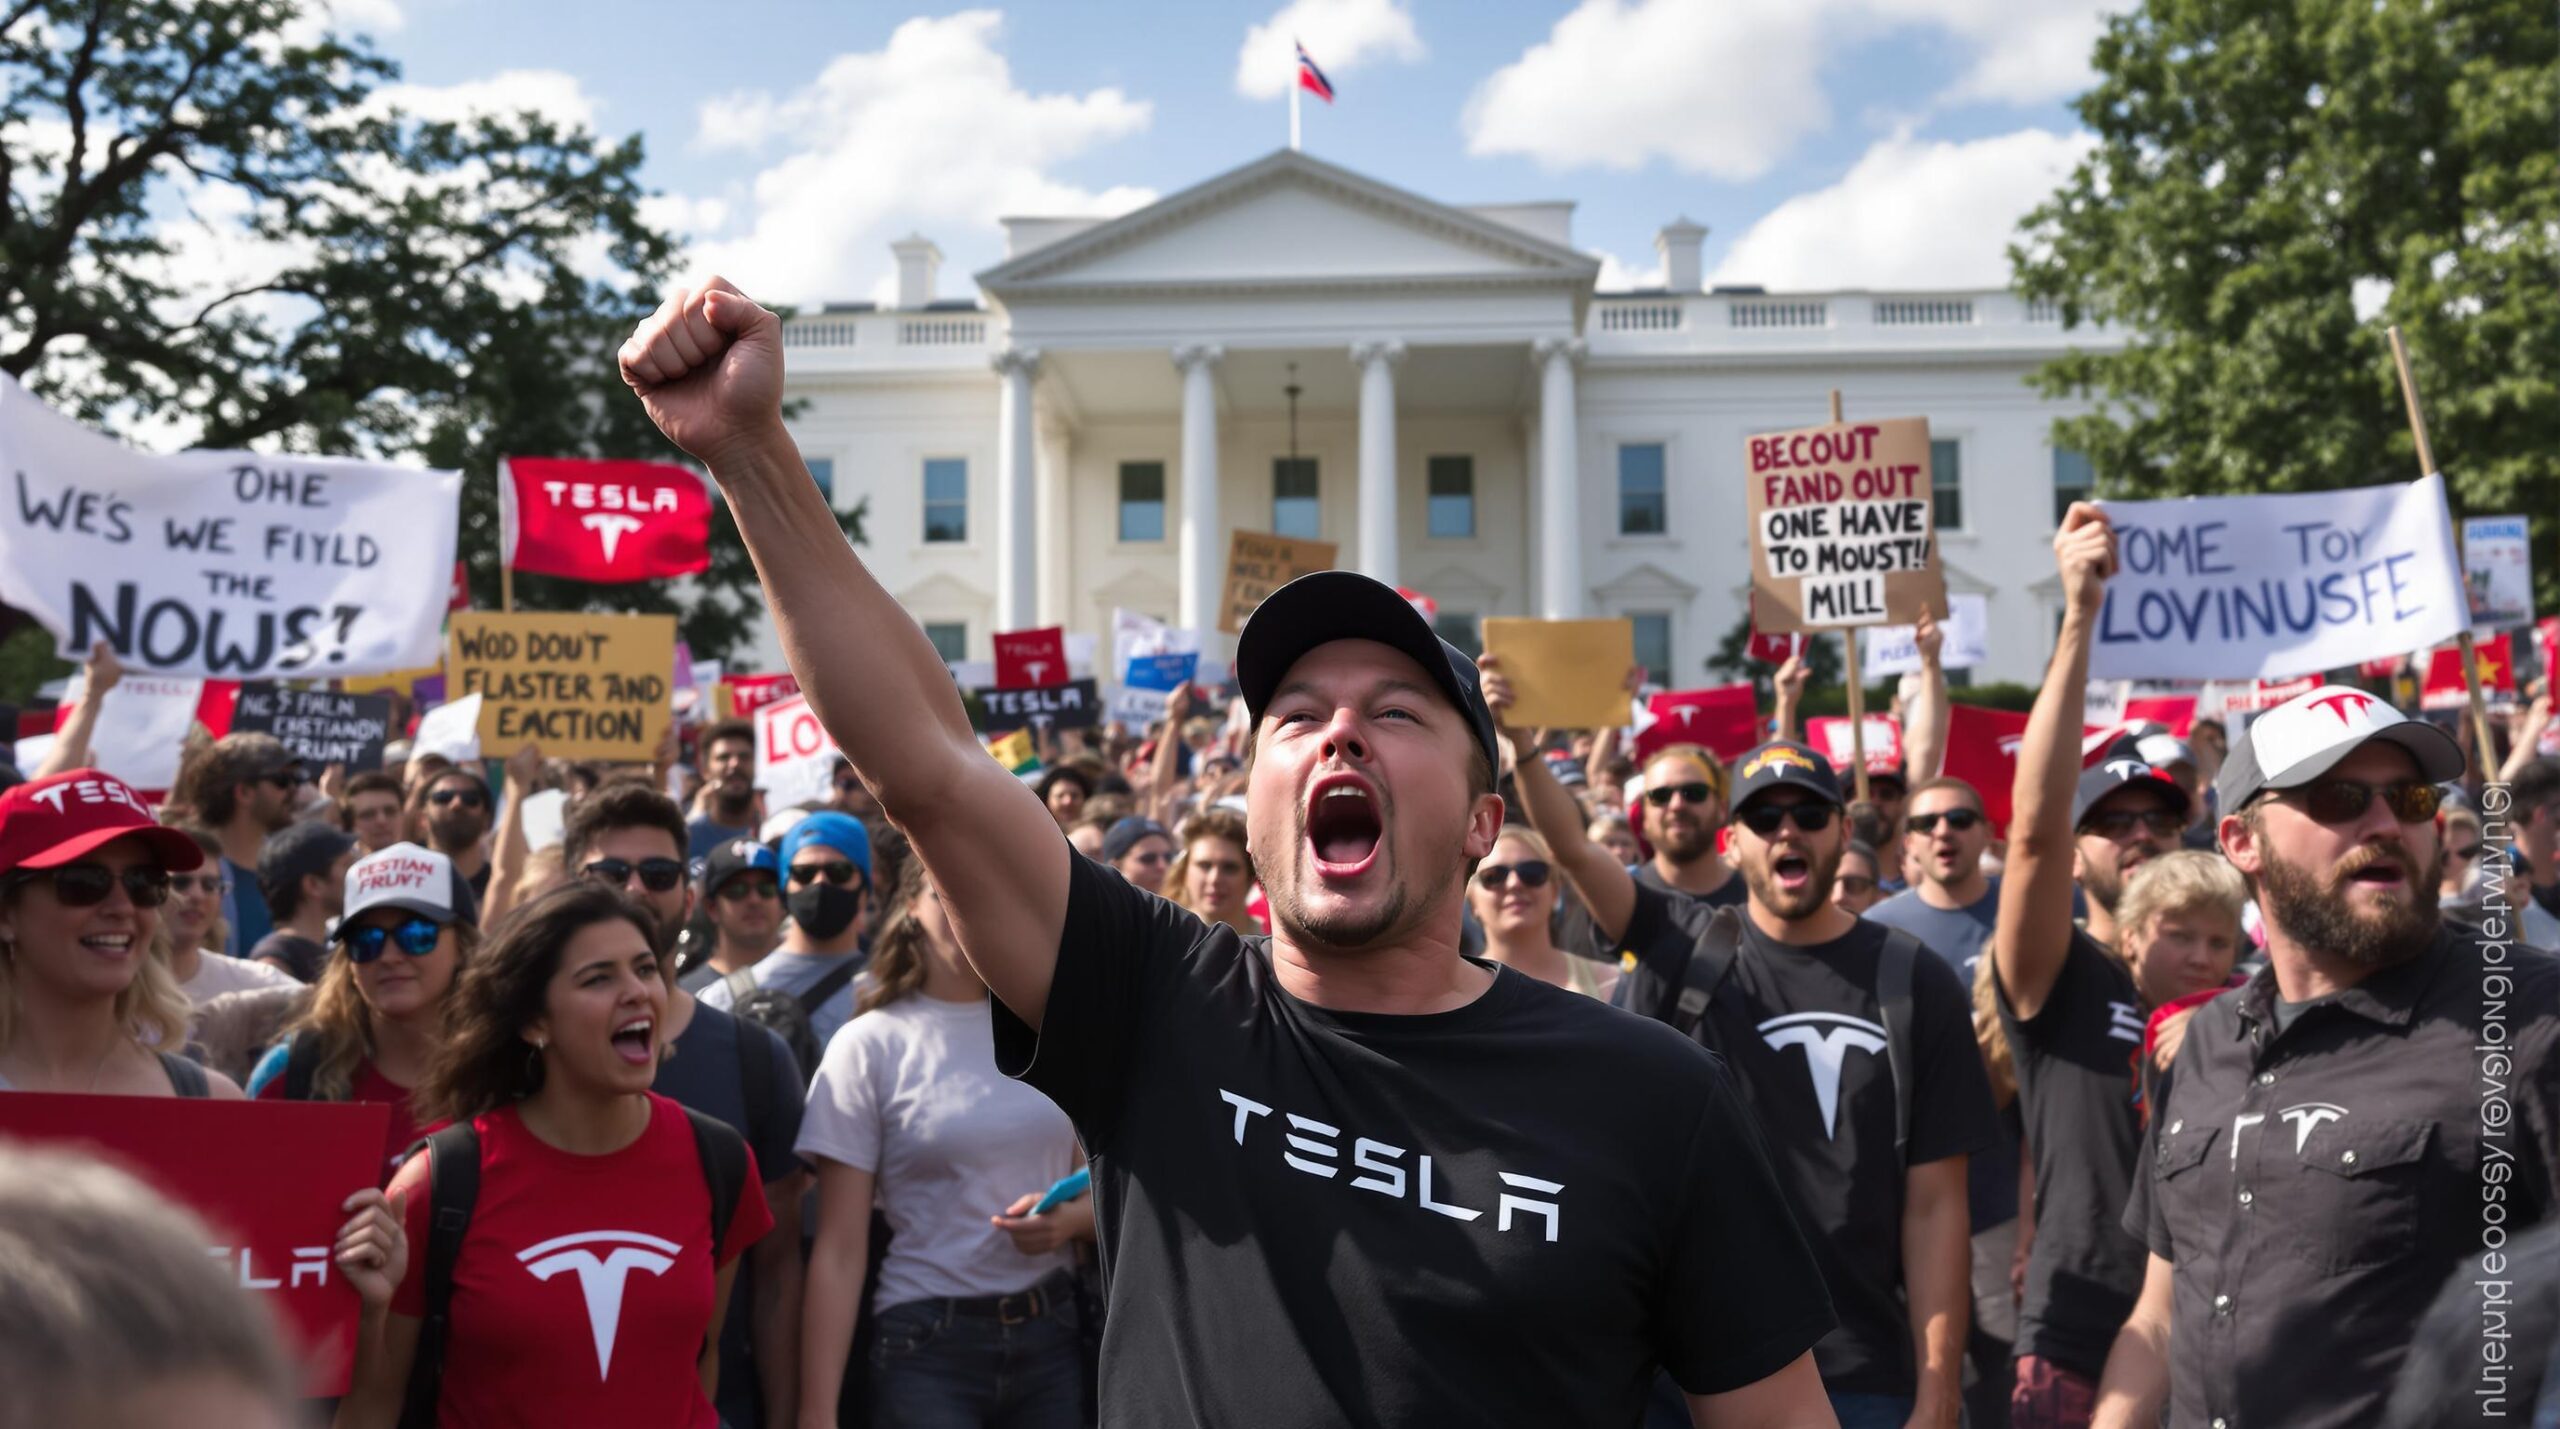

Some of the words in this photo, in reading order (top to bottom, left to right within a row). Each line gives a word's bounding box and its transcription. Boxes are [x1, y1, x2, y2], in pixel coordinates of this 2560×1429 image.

[1751, 426, 1879, 471] BECOUT
[543, 480, 678, 513] TESLA
[1765, 472, 1843, 506] FAND
[1853, 465, 1919, 499] OUT
[17, 470, 133, 543] WE'S
[165, 518, 236, 553] WE
[1768, 504, 1829, 540] ONE
[1840, 502, 1924, 536] HAVE
[1769, 546, 1808, 573] TO
[202, 571, 275, 600] THE
[981, 687, 1082, 714] TESLA
[766, 713, 838, 765] LO
[30, 779, 159, 824] TESL
[1219, 1088, 1565, 1242] TESLA
